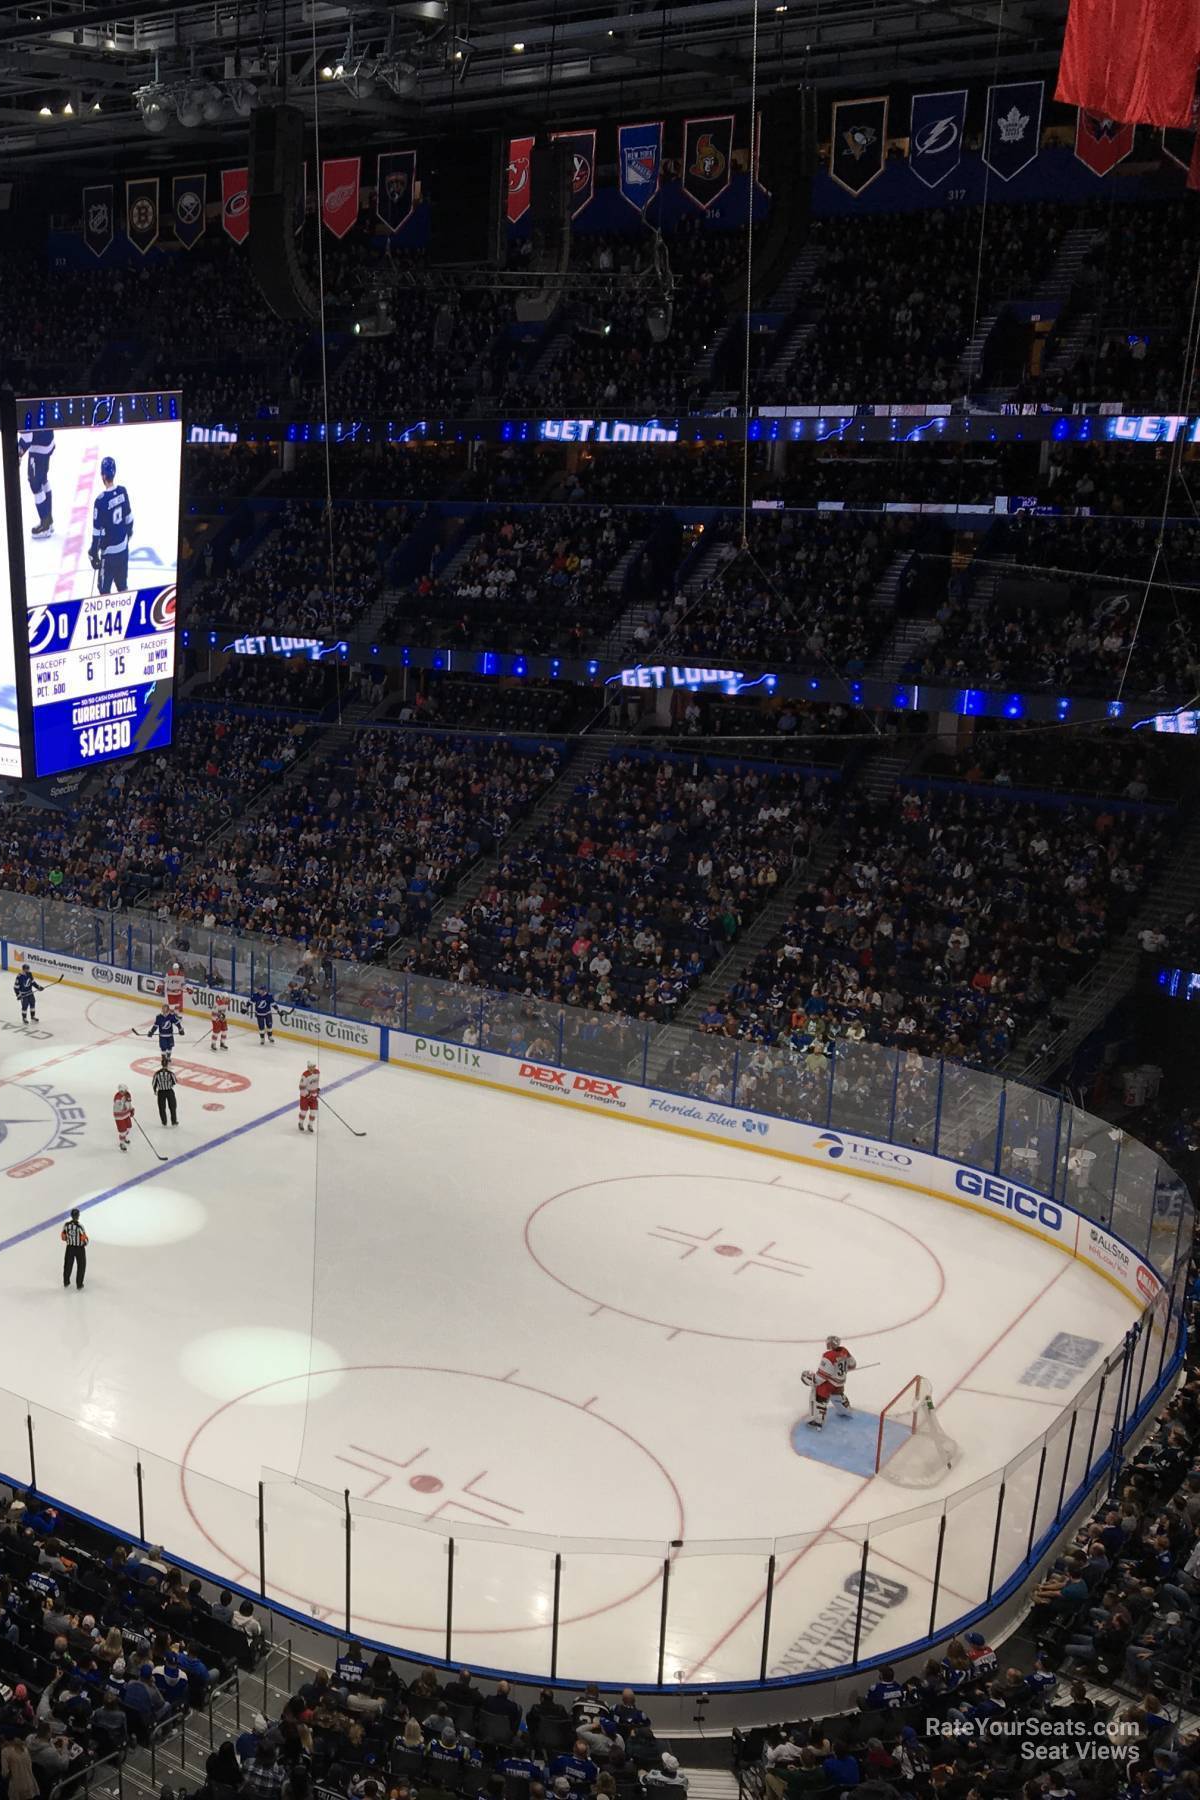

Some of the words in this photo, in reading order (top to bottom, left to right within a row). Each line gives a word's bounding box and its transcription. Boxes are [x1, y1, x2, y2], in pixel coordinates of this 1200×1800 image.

[545, 420, 593, 442] GET
[1114, 416, 1186, 442] GET
[84, 602, 103, 613] 2ND
[105, 597, 132, 610] Period
[139, 600, 147, 625] 1
[58, 613, 68, 639] 0
[86, 611, 122, 640] 11:44
[109, 646, 130, 656] SHOTS
[140, 639, 168, 650] FACEOFF
[155, 649, 168, 659] WON
[234, 636, 266, 655] GET
[36, 658, 66, 670] FACEOFF
[79, 652, 101, 662] SHOTS
[114, 656, 125, 675] 15
[37, 671, 51, 684] WON
[53, 671, 59, 681] 15
[87, 662, 94, 681] 6
[621, 666, 666, 688] GET
[72, 701, 110, 725] CURRENT
[112, 696, 137, 716] TOTAL
[1154, 710, 1200, 735] GE
[79, 719, 130, 758] $14330
[27, 953, 84, 973] MicroLumen
[96, 968, 110, 979] FOX
[115, 973, 133, 986] SUN
[280, 1011, 321, 1033] Times
[325, 1020, 368, 1045] Times
[415, 1038, 481, 1068] Publix
[519, 1063, 567, 1086] DEX
[529, 1078, 571, 1096] imaging
[573, 1075, 623, 1099] DEX
[584, 1091, 627, 1108] imaging
[25, 1083, 88, 1152] ARENA
[649, 1098, 704, 1121] Florida
[706, 1112, 738, 1129] Blue
[847, 1141, 913, 1167] TECO
[955, 1169, 1062, 1231] GEICO
[770, 1595, 853, 1675] INSURANC
